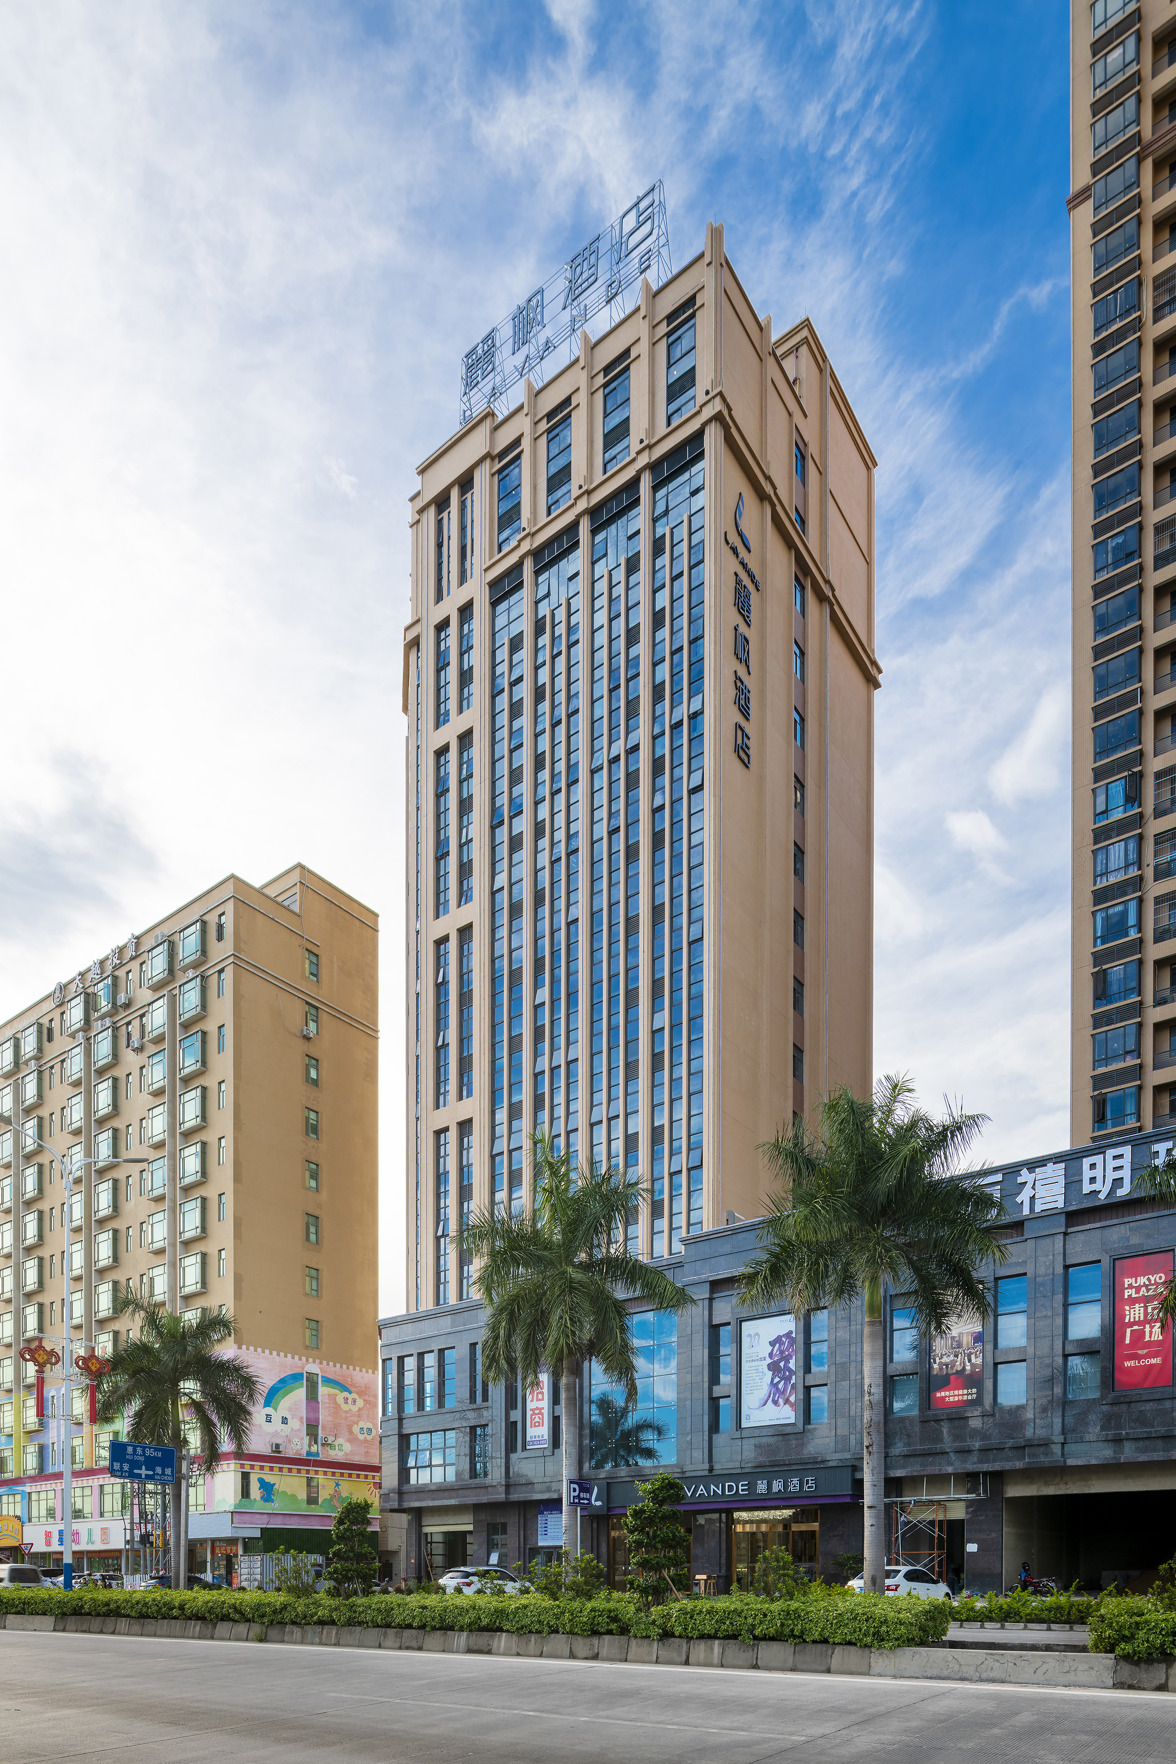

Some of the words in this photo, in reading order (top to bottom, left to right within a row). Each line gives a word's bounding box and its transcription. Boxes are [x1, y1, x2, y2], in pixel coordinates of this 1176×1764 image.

[1124, 1273, 1166, 1288] PUKYO
[1124, 1322, 1163, 1345] 广场
[1124, 1357, 1162, 1367] WELCOME
[265, 1413, 289, 1425] 互助
[126, 1446, 143, 1455] 惠东
[155, 1466, 172, 1475] 海城
[570, 1483, 579, 1503] P
[684, 1481, 749, 1497] VANDE
